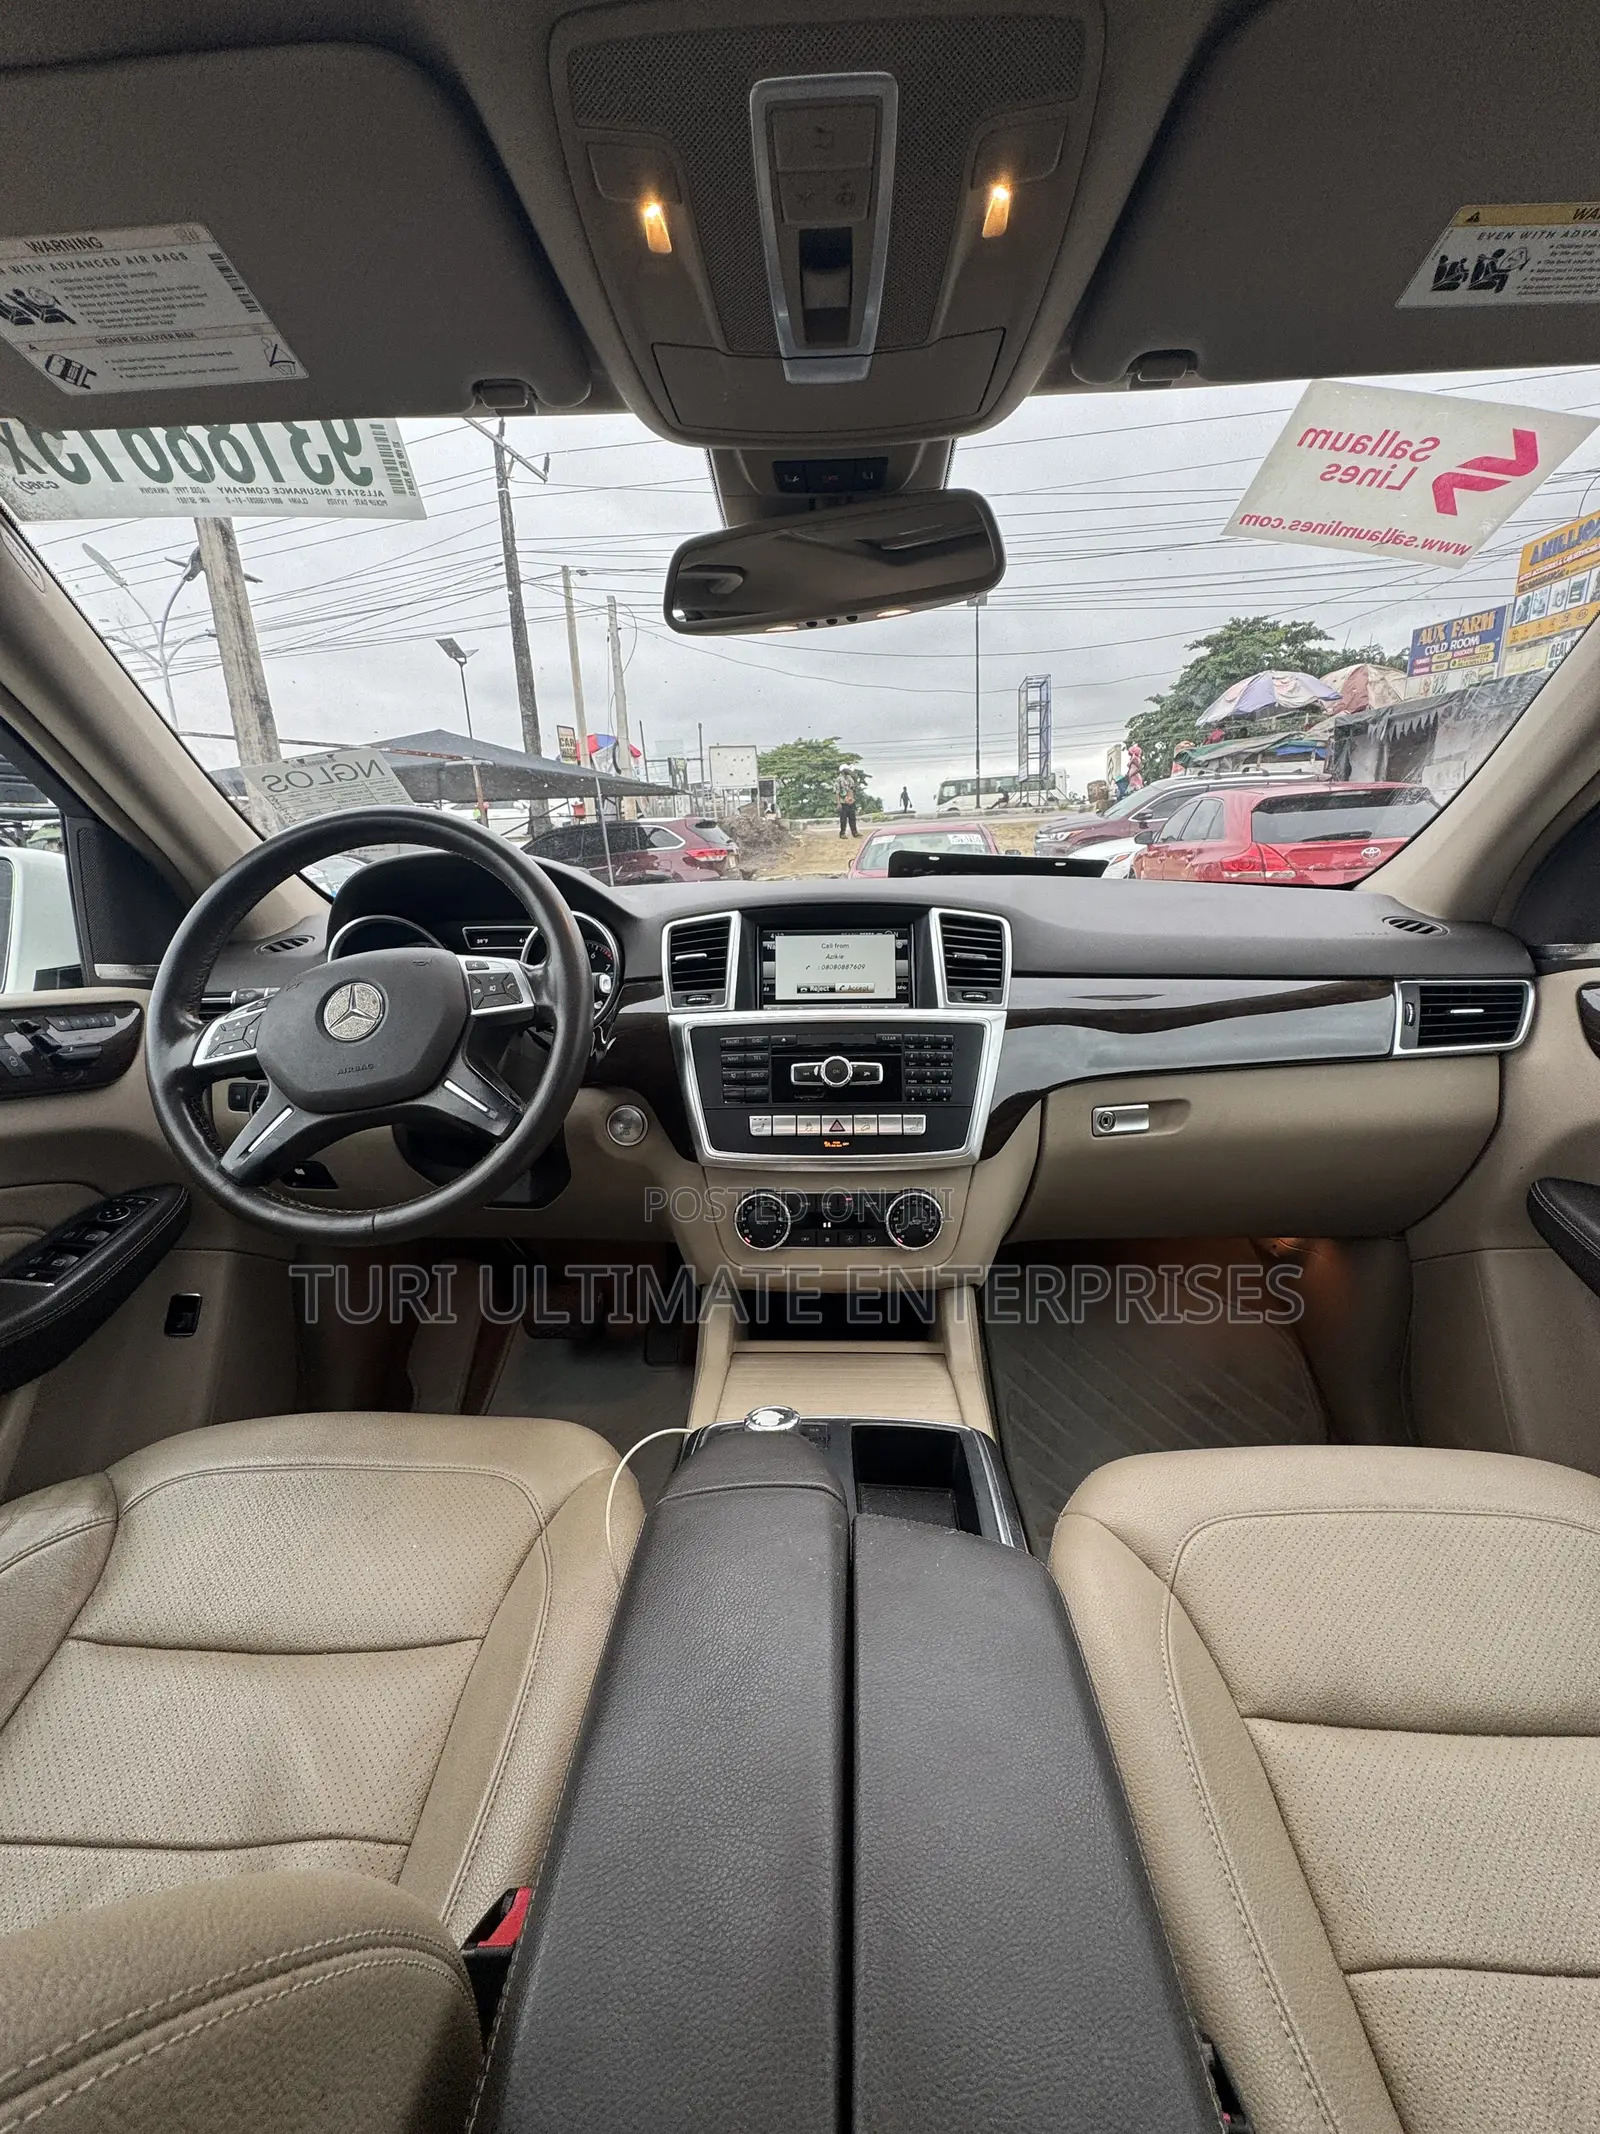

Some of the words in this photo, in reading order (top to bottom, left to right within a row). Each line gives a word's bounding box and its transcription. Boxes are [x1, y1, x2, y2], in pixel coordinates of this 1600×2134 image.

[1573, 207, 1600, 220] WA
[1477, 231, 1516, 240] EVEN
[1520, 230, 1557, 240] WITH
[25, 236, 104, 254] WARNING
[9, 263, 46, 275] WITH
[50, 257, 121, 272] ADVANCED
[126, 255, 149, 265] AIR
[152, 251, 189, 263] BAGS
[96, 335, 130, 345] HIGHER
[131, 333, 174, 343] ROLLOVER
[174, 331, 198, 340] RISK
[1419, 624, 1447, 645] AUX
[1451, 610, 1496, 638] FARM
[1425, 643, 1448, 656] COLD
[1450, 635, 1480, 651] ROOM
[560, 737, 576, 748] CAR
[809, 985, 830, 993] Reject
[337, 1063, 375, 1075] AIRBAG
